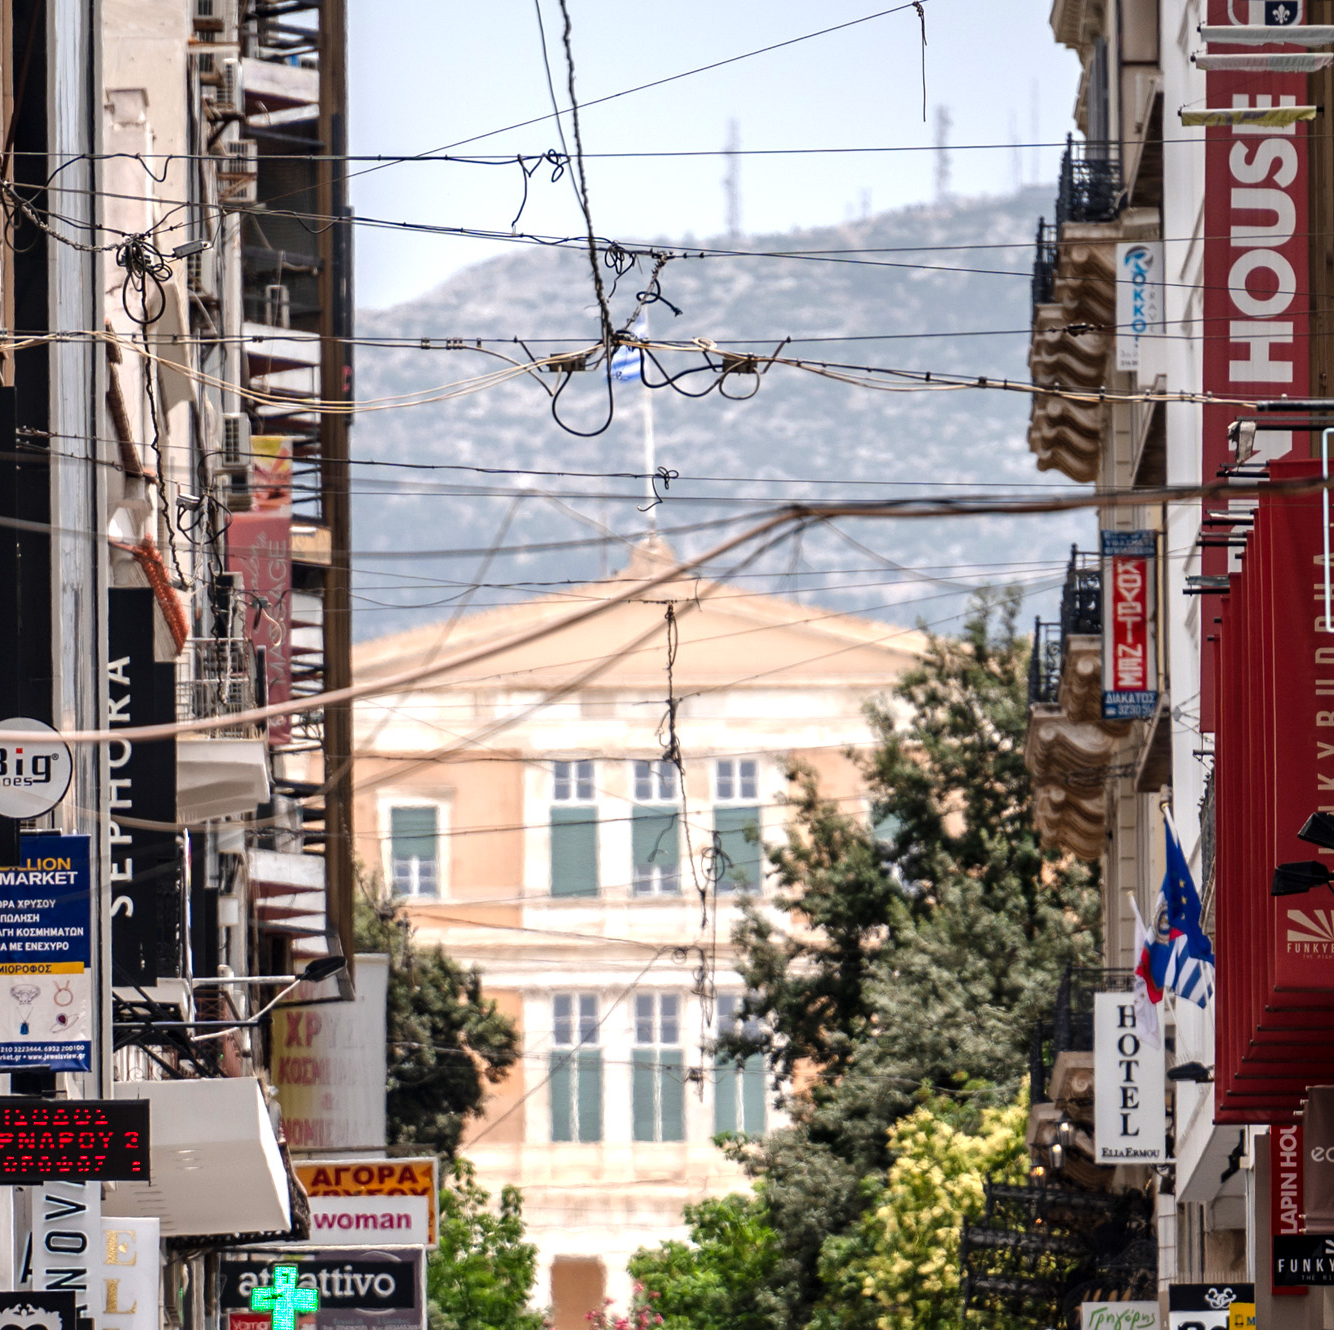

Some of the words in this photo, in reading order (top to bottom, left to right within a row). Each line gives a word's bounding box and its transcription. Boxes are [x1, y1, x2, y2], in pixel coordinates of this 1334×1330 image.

[108, 655, 134, 918] SEPHORA
[17, 899, 56, 909] ΧΡΥΣΟΥ
[0, 913, 40, 923] ΠΩΛΗΣΗ
[16, 927, 84, 937] ΚΟΣΜΗΜΑΤΩΝ
[9, 942, 23, 951] ΜΕ
[25, 941, 69, 951] ΕΝΕΧΥΡΟ
[1116, 1004, 1140, 1137] HOTEL
[311, 1165, 419, 1188] ΑΓΟΡΑ
[1280, 1172, 1298, 1235] LAPIN
[313, 1212, 413, 1230] woman
